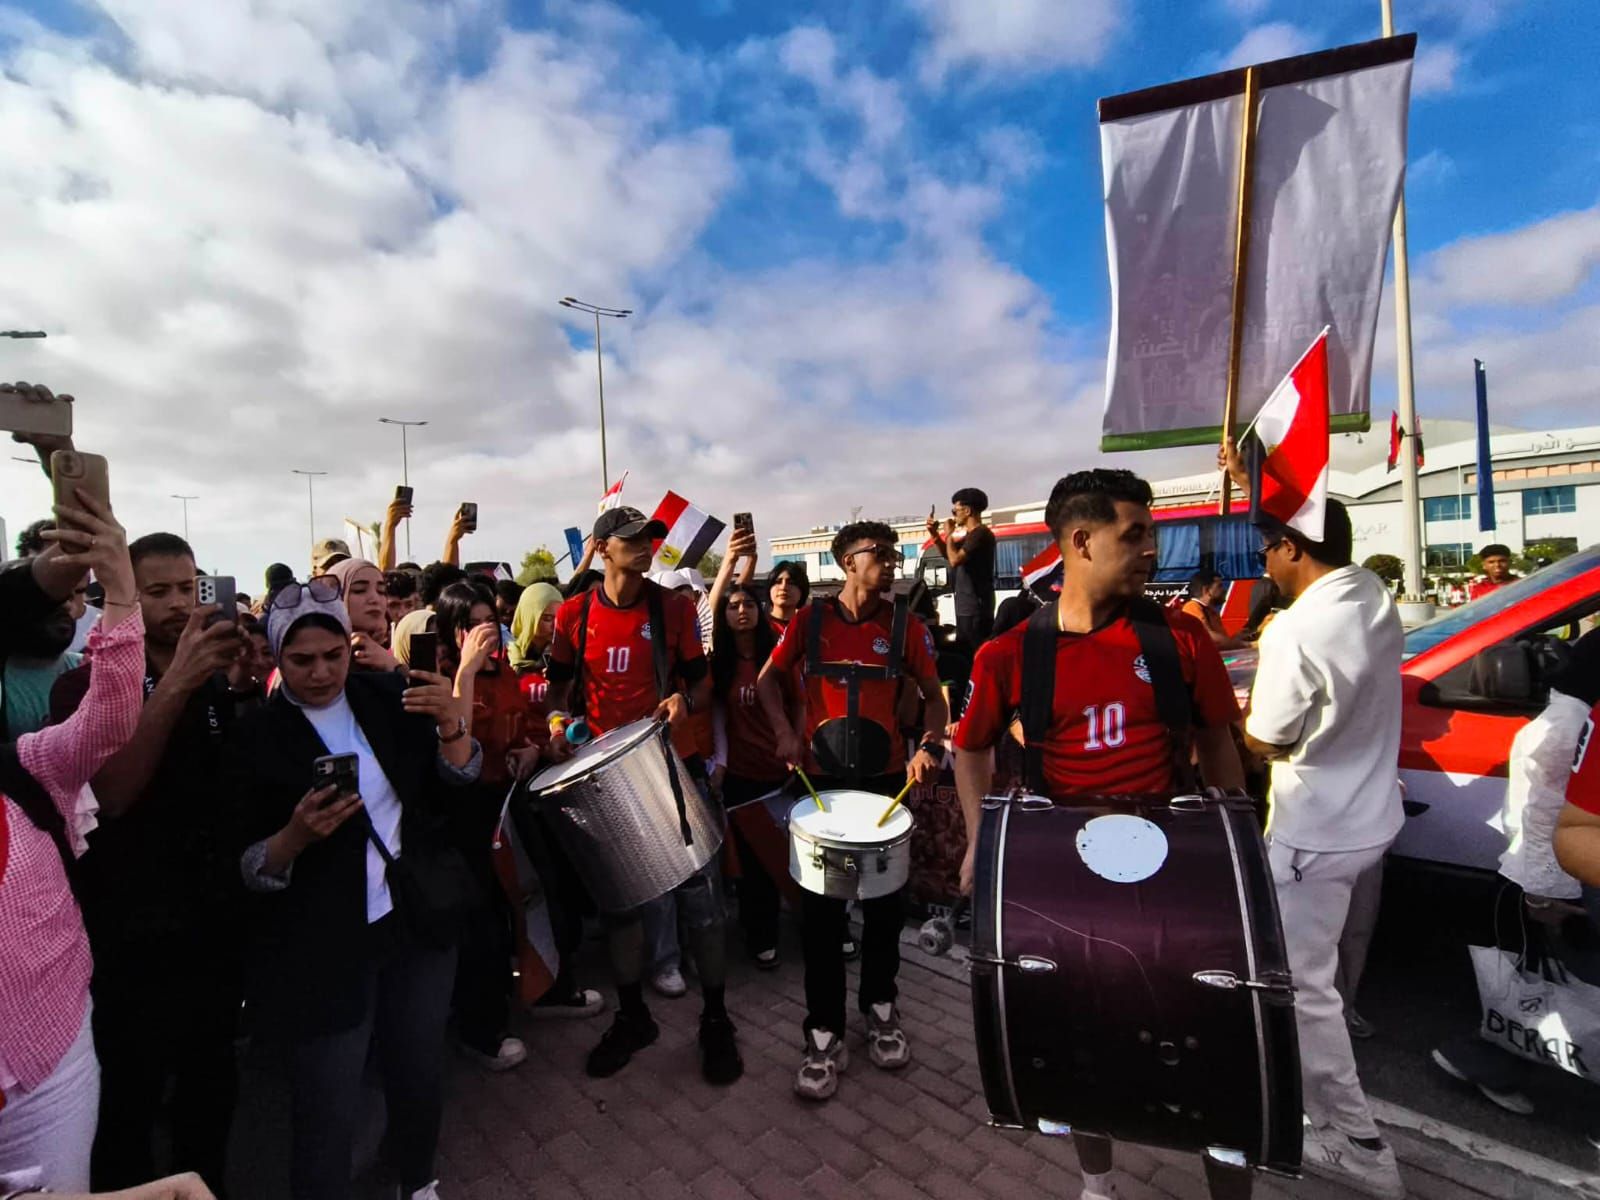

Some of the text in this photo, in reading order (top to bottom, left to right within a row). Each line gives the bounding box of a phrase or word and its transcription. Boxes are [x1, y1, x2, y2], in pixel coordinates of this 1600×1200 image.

[606, 646, 631, 673] 10
[528, 682, 548, 703] 10
[1082, 701, 1127, 751] 10
